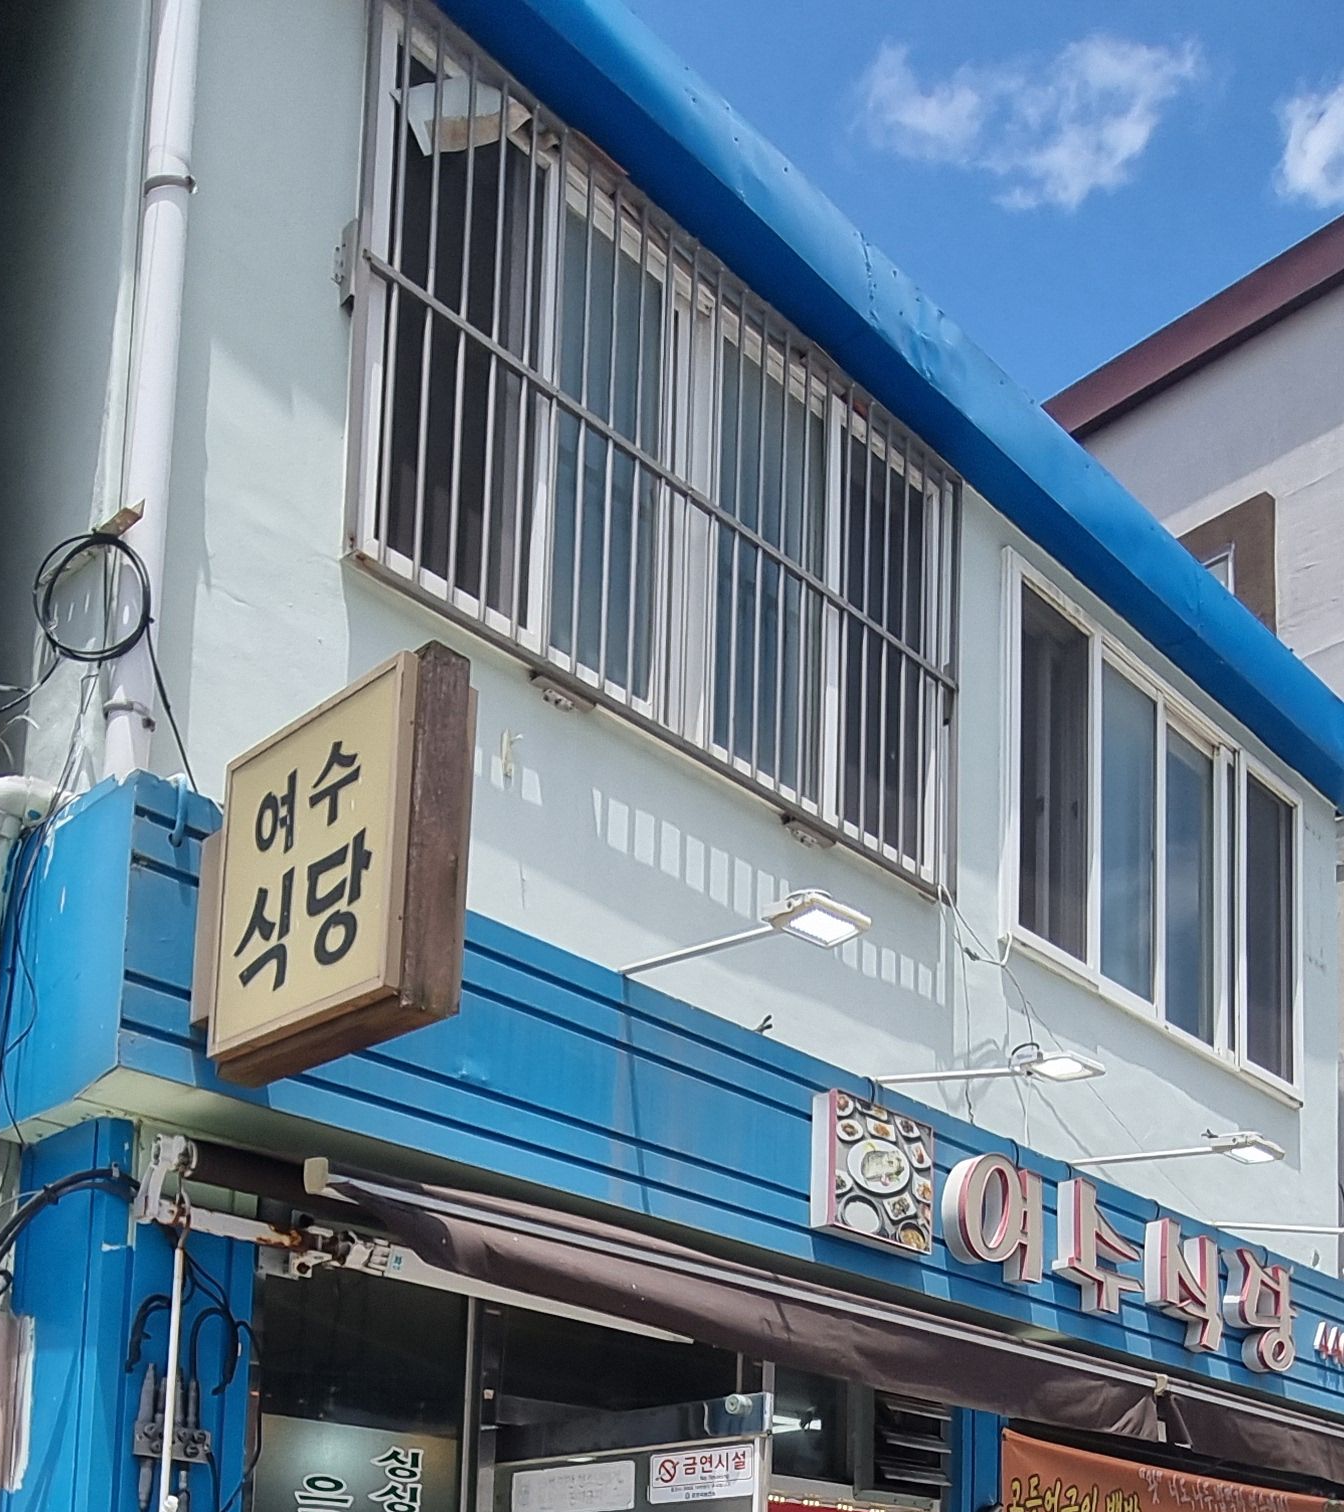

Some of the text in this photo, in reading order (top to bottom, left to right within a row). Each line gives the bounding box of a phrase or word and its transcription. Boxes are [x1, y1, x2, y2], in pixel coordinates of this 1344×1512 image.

[255, 740, 362, 854] 여수
[232, 827, 373, 992] 식당
[942, 1151, 1298, 1374] 여수식당
[682, 1450, 746, 1476] 금연시설
